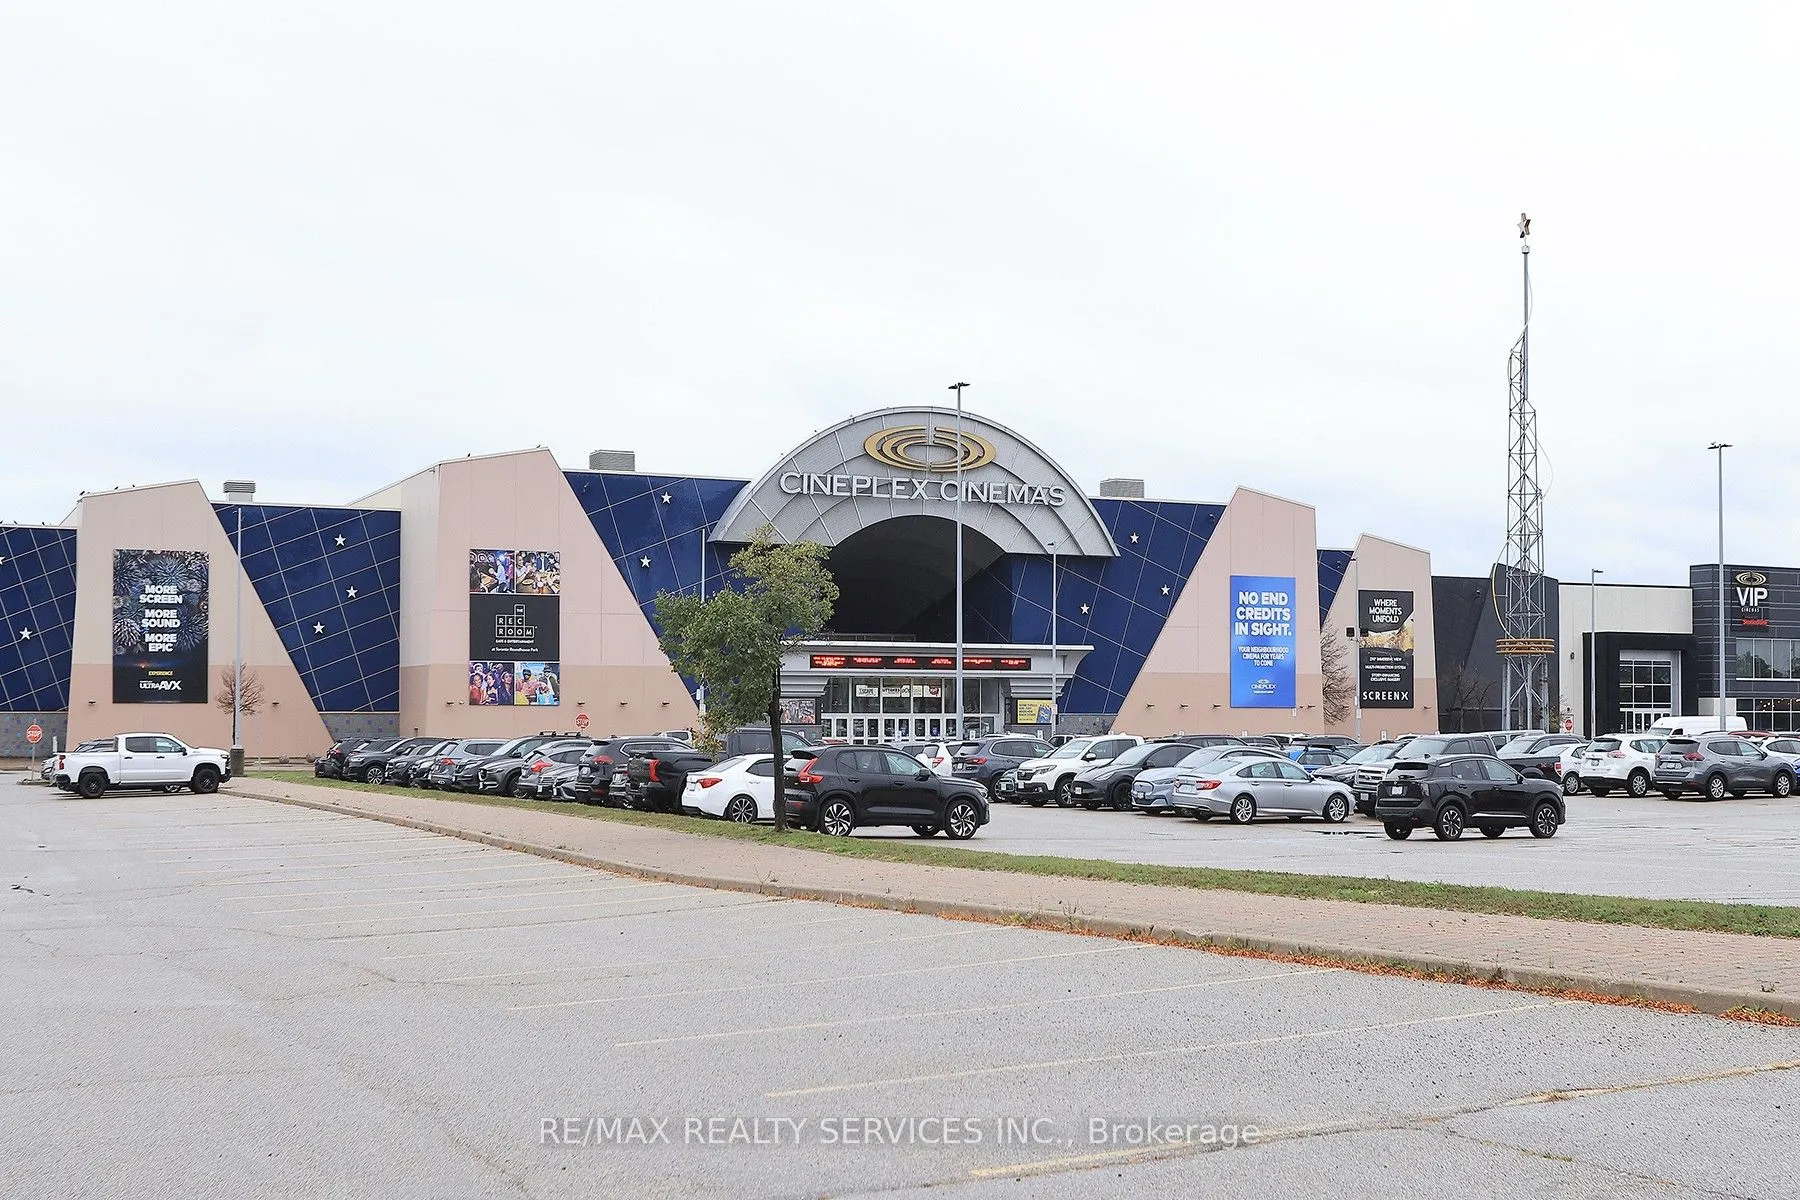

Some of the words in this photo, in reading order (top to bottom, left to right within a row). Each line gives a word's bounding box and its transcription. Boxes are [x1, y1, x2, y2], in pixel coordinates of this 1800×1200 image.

[779, 471, 929, 500] CINEPLEX
[939, 480, 1067, 507] CINEMAS
[145, 585, 178, 594] MORE
[139, 594, 183, 604] SCREEN
[1239, 591, 1259, 605] NO
[1261, 591, 1289, 606] END
[1736, 587, 1768, 607] VIP
[1373, 598, 1398, 607] WHERE
[145, 609, 178, 618] MORE
[1236, 606, 1291, 621] CREDITS
[1369, 606, 1403, 615] MOMENTS
[141, 618, 181, 628] SOUND
[498, 617, 523, 625] REC
[1372, 614, 1400, 623] UNFOLD
[498, 628, 533, 636] ROOM
[1235, 622, 1249, 636] IN
[1251, 622, 1292, 636] SIGHT.
[145, 633, 178, 643] MORE
[148, 642, 174, 652] EPIC
[1362, 691, 1409, 701] SCREENX
